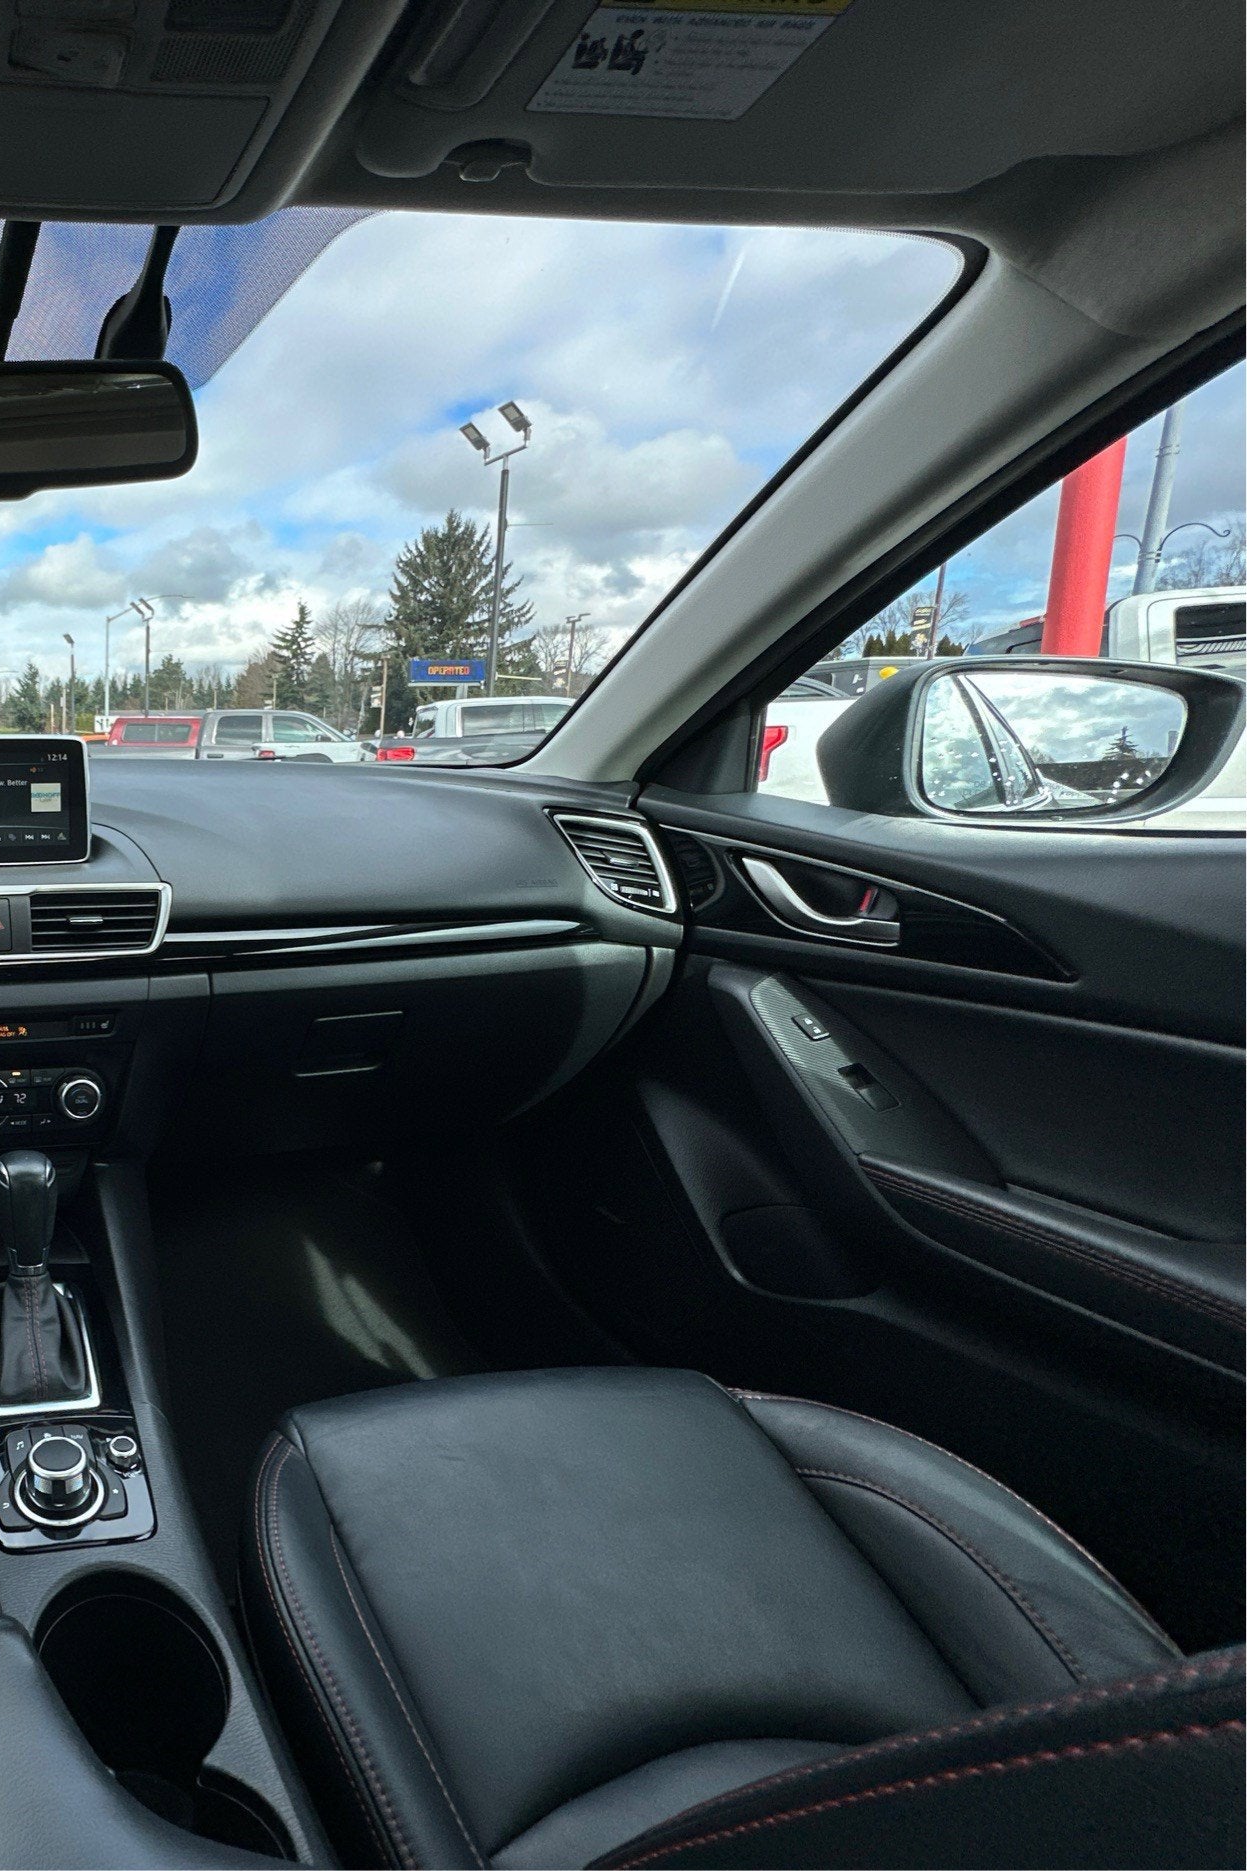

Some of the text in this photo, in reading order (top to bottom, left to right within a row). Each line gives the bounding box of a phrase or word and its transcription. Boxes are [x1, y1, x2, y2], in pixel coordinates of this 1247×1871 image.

[427, 666, 471, 676] OPERATED
[47, 753, 68, 762] 12:14
[13, 1093, 27, 1104] 72
